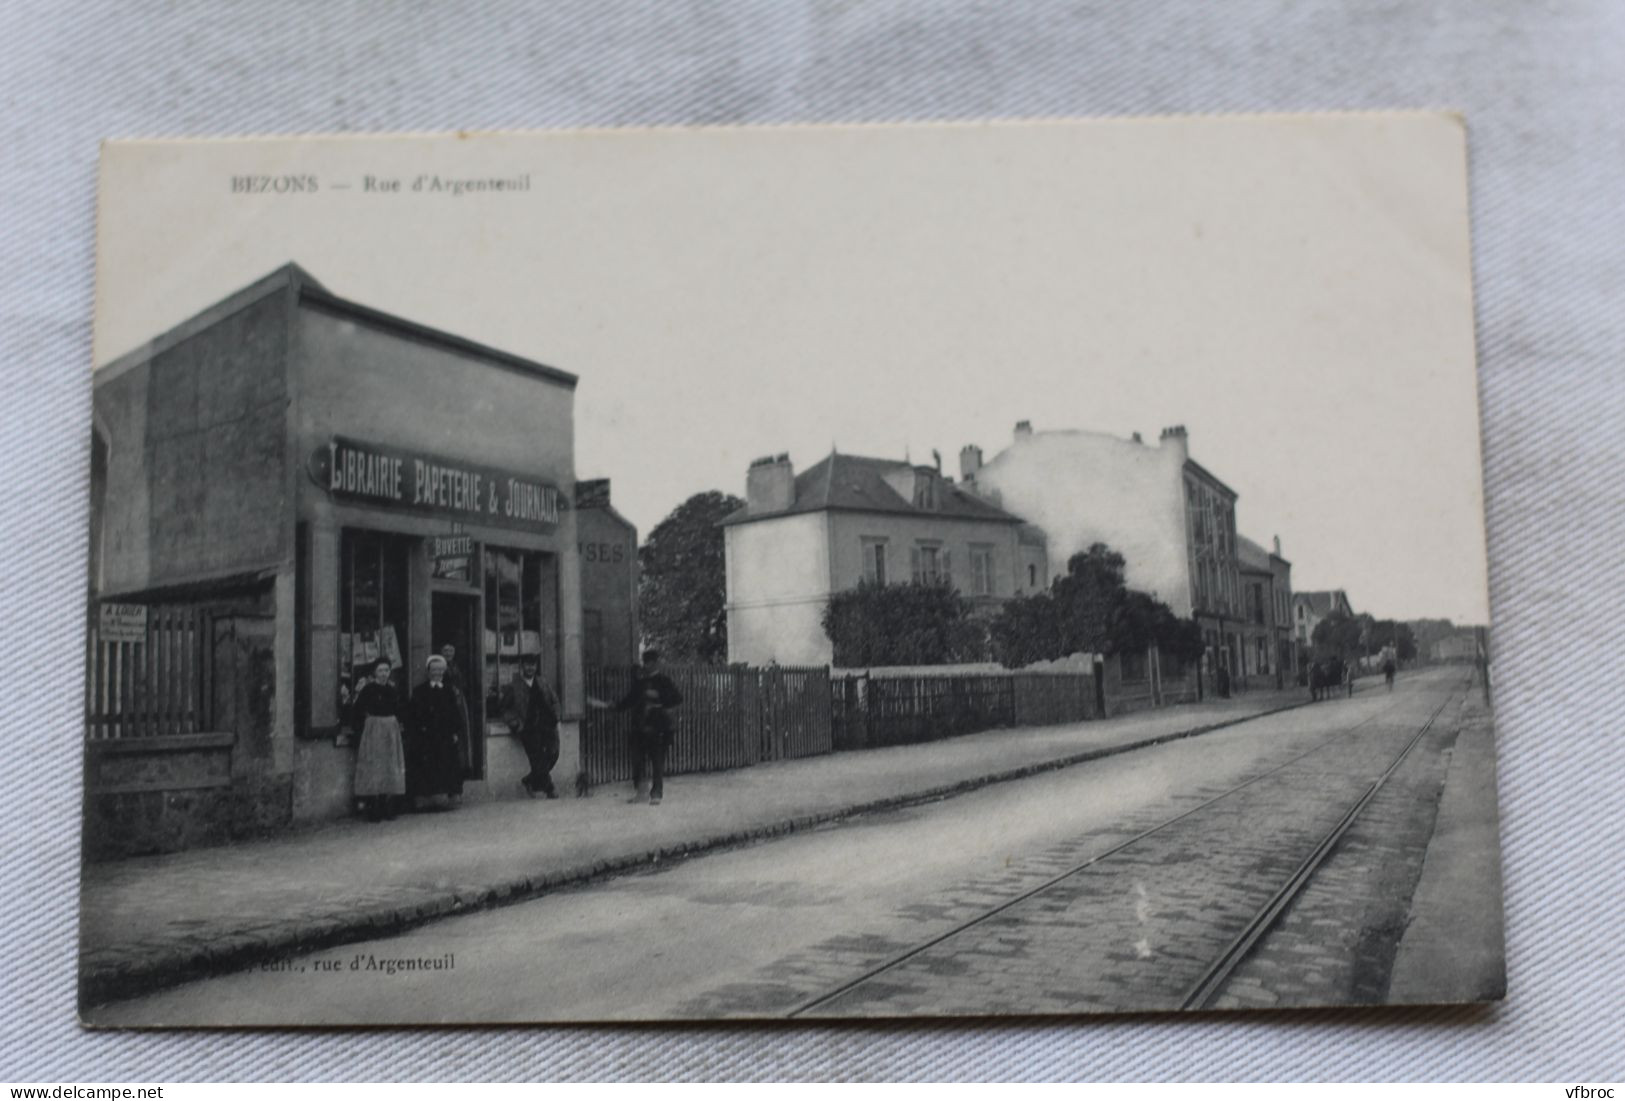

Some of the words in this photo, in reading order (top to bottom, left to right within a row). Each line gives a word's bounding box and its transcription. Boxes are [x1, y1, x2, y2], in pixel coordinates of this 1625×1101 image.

[230, 175, 319, 194] BEZONS
[363, 175, 400, 193] Rue
[412, 174, 531, 195] d'Argenteuil
[329, 441, 403, 500] LIBRAIRIE
[413, 458, 482, 513] PAPETERIE
[489, 481, 499, 515] &
[505, 477, 559, 524] JOURNAUX
[435, 536, 473, 557] BUVETTE
[313, 959, 342, 972] rue
[350, 953, 455, 975] d'Argenteuil
